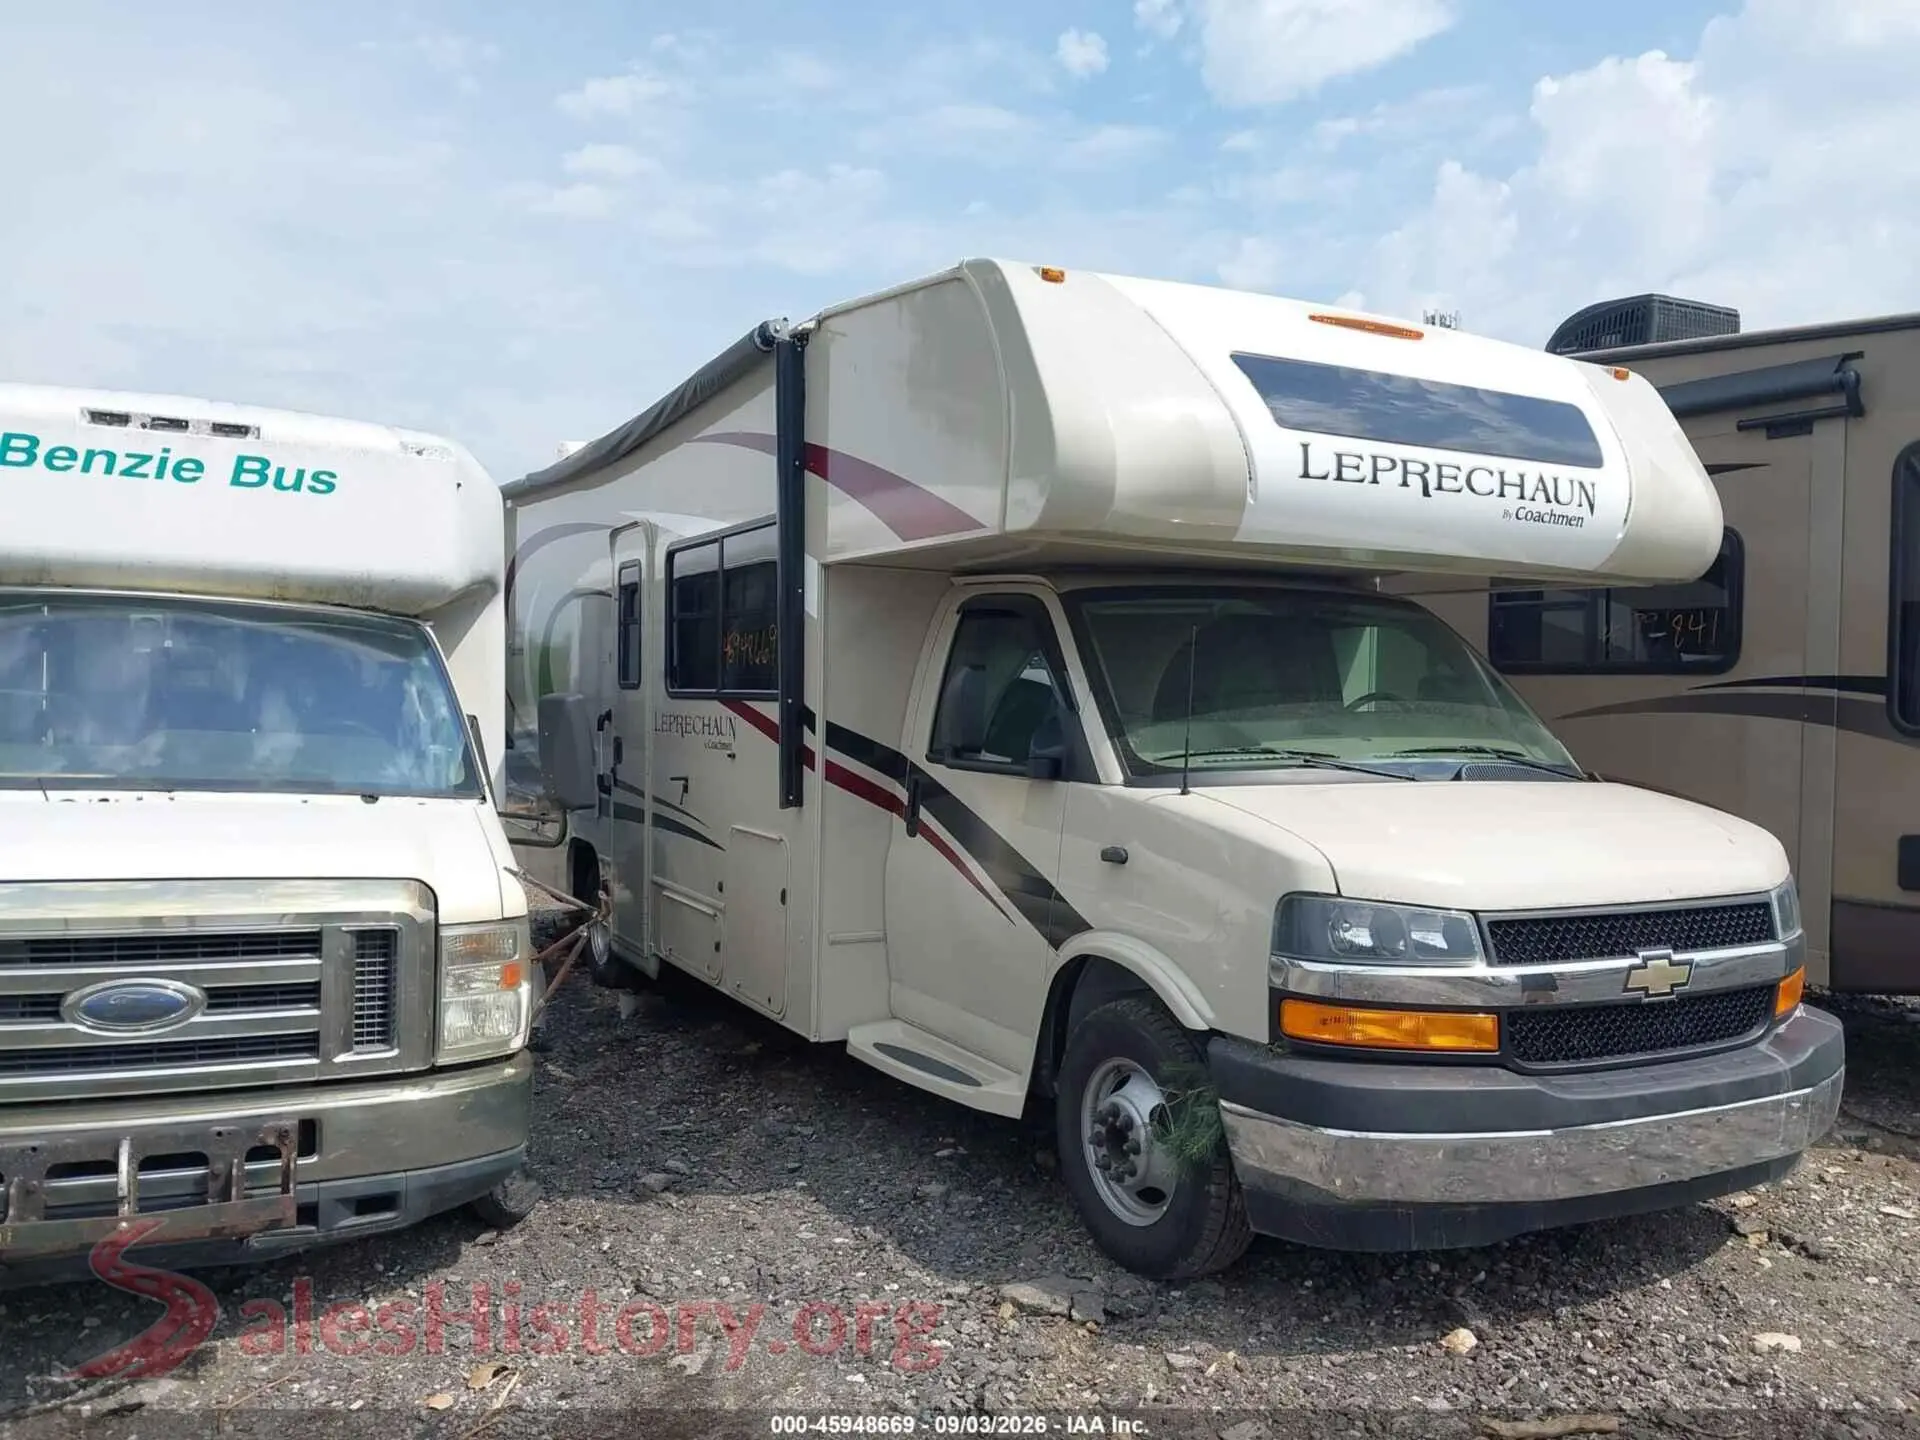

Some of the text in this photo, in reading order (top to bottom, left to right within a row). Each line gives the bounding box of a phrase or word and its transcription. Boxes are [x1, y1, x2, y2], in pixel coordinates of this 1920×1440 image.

[0, 432, 338, 495] Benzie Bus
[1299, 442, 1596, 517] LEPRECHAUN
[1502, 506, 1584, 528] By Coachmen
[654, 711, 737, 742] LEPRECHAUN
